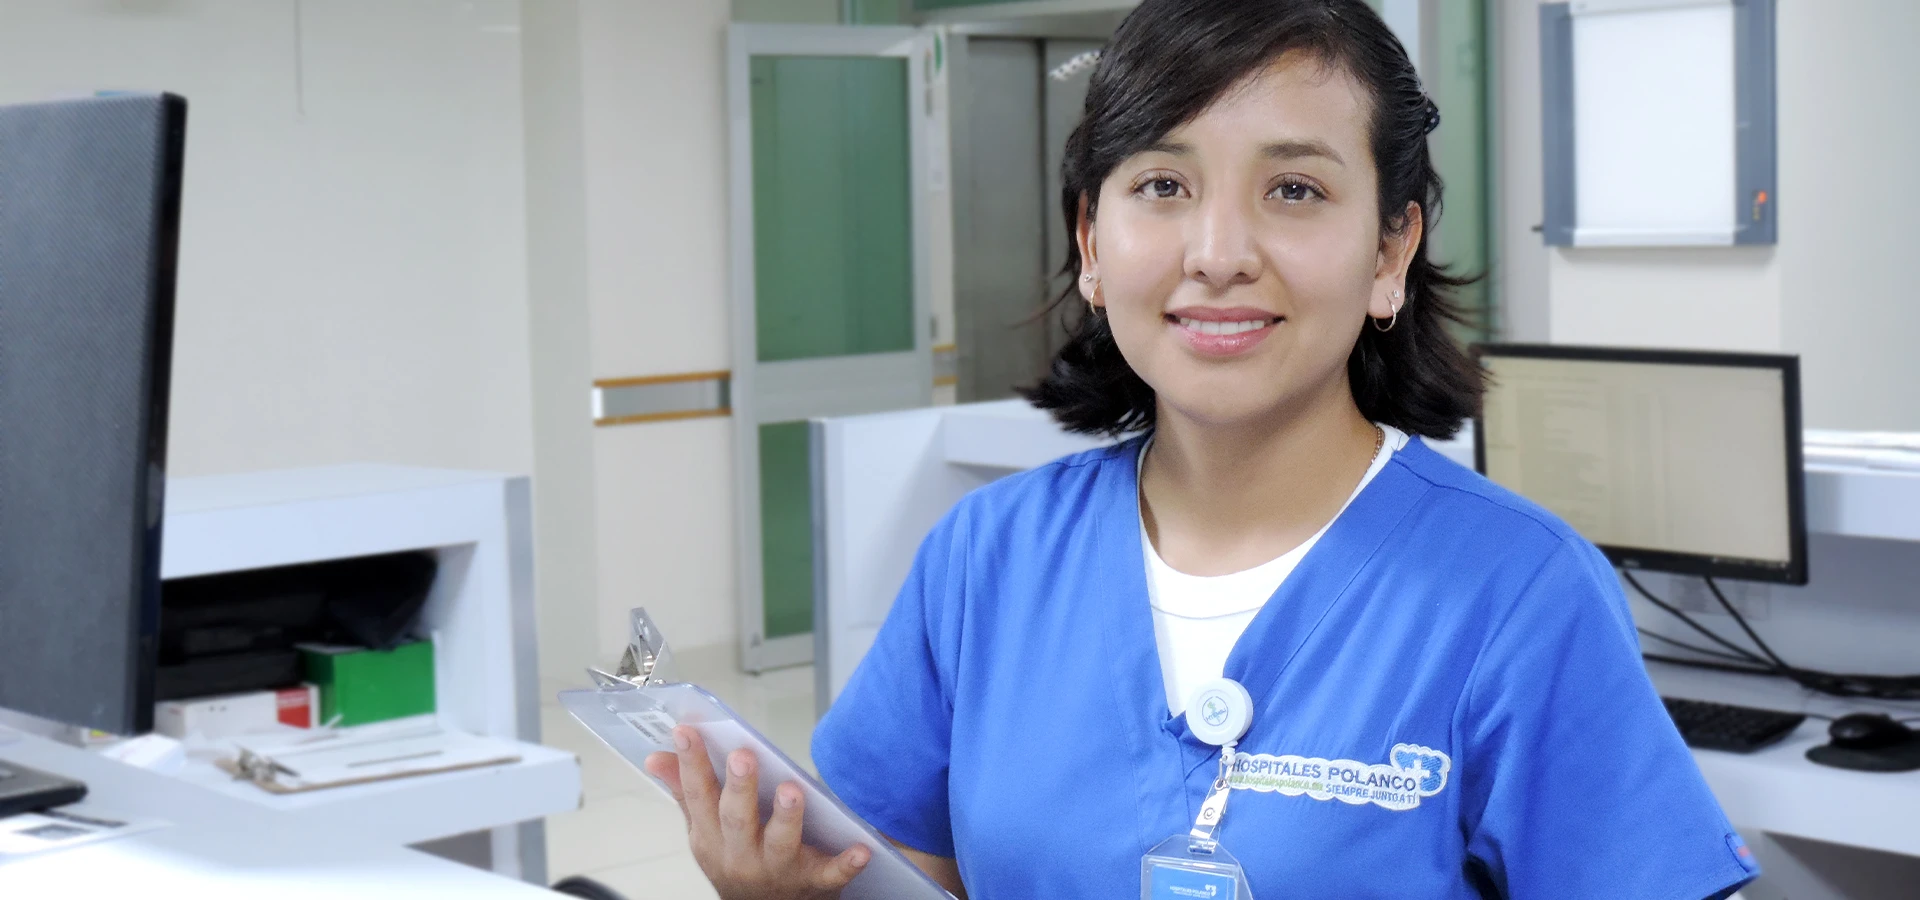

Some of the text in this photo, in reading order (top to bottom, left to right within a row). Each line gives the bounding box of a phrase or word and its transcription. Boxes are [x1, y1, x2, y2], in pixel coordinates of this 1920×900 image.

[1231, 758, 1416, 791] HOSPITALES POLANCO
[1326, 783, 1369, 798] SIEMPRE
